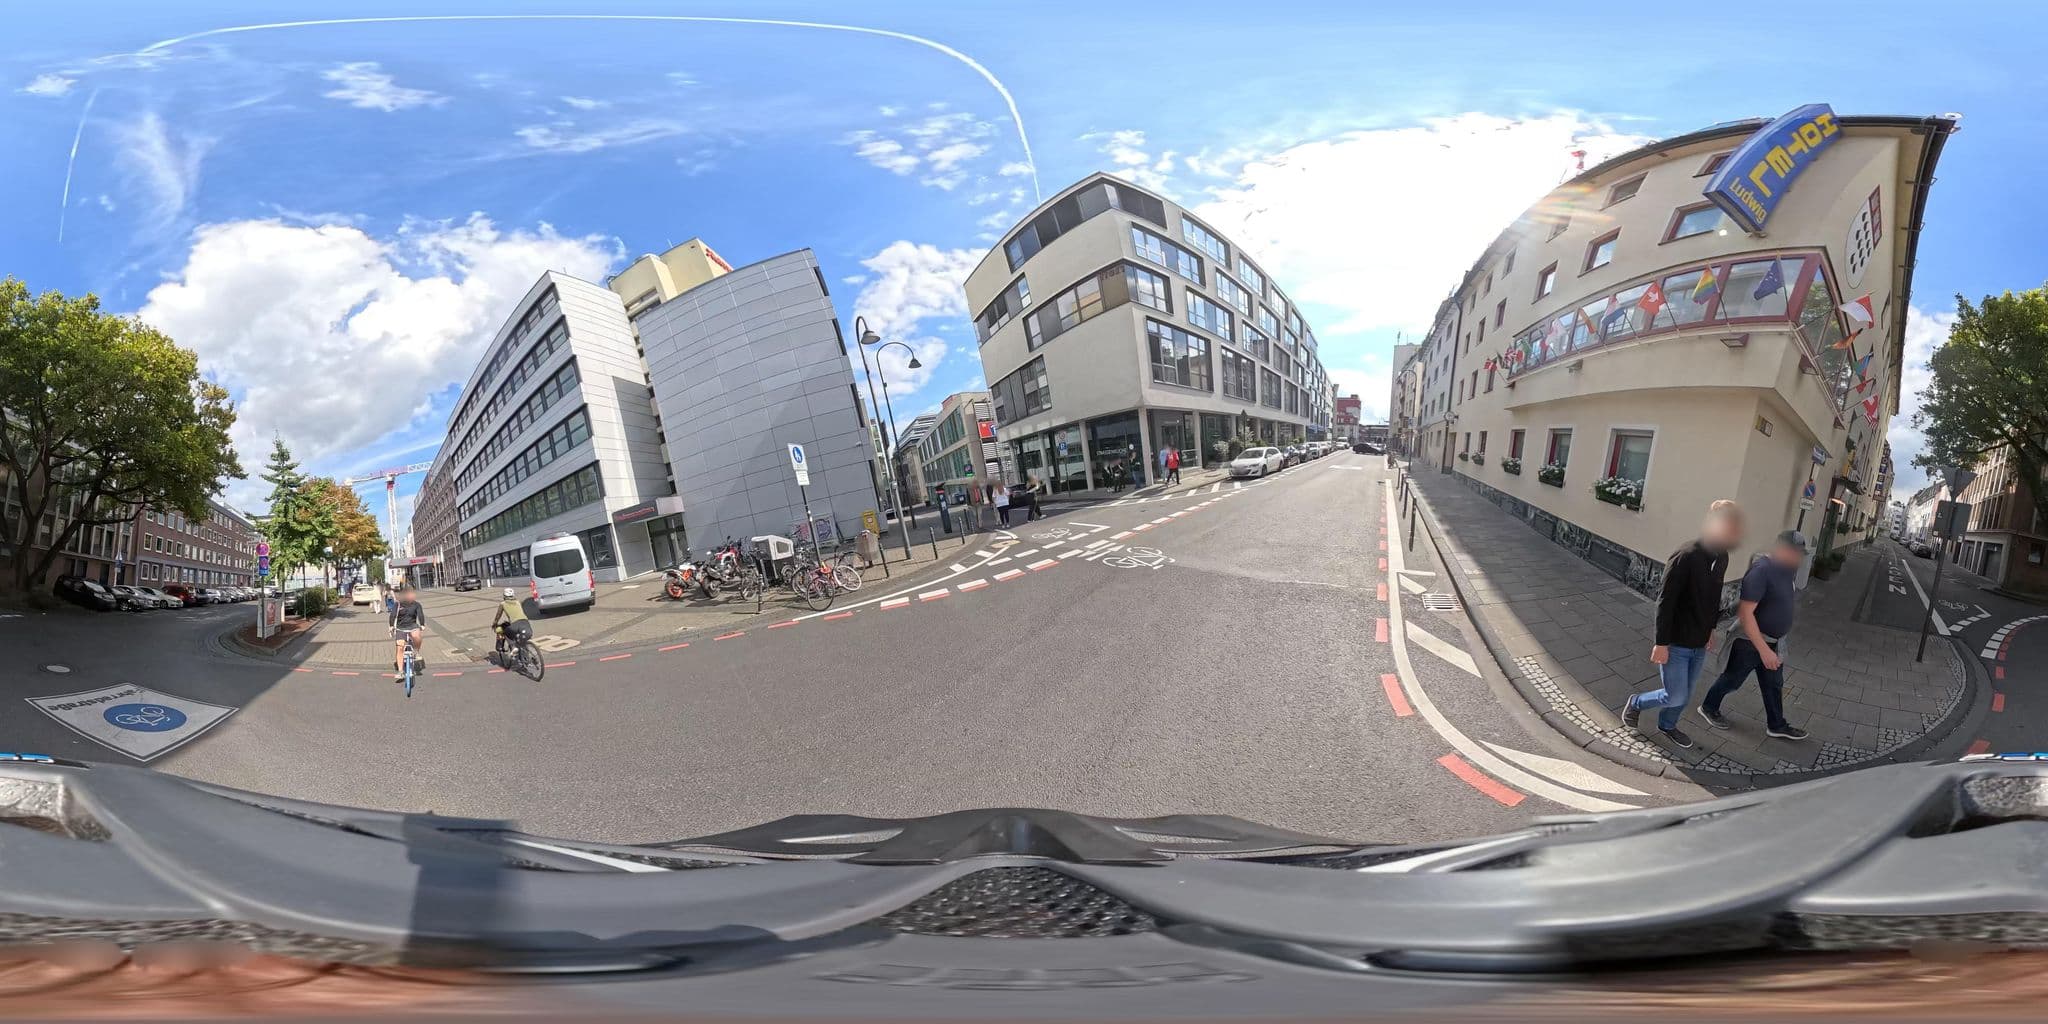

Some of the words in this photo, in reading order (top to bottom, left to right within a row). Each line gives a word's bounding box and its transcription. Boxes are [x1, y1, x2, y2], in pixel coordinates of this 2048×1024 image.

[1748, 113, 1839, 198] HOTEL
[1729, 177, 1768, 224] Ludwig
[1876, 448, 1890, 491] HOTEL
